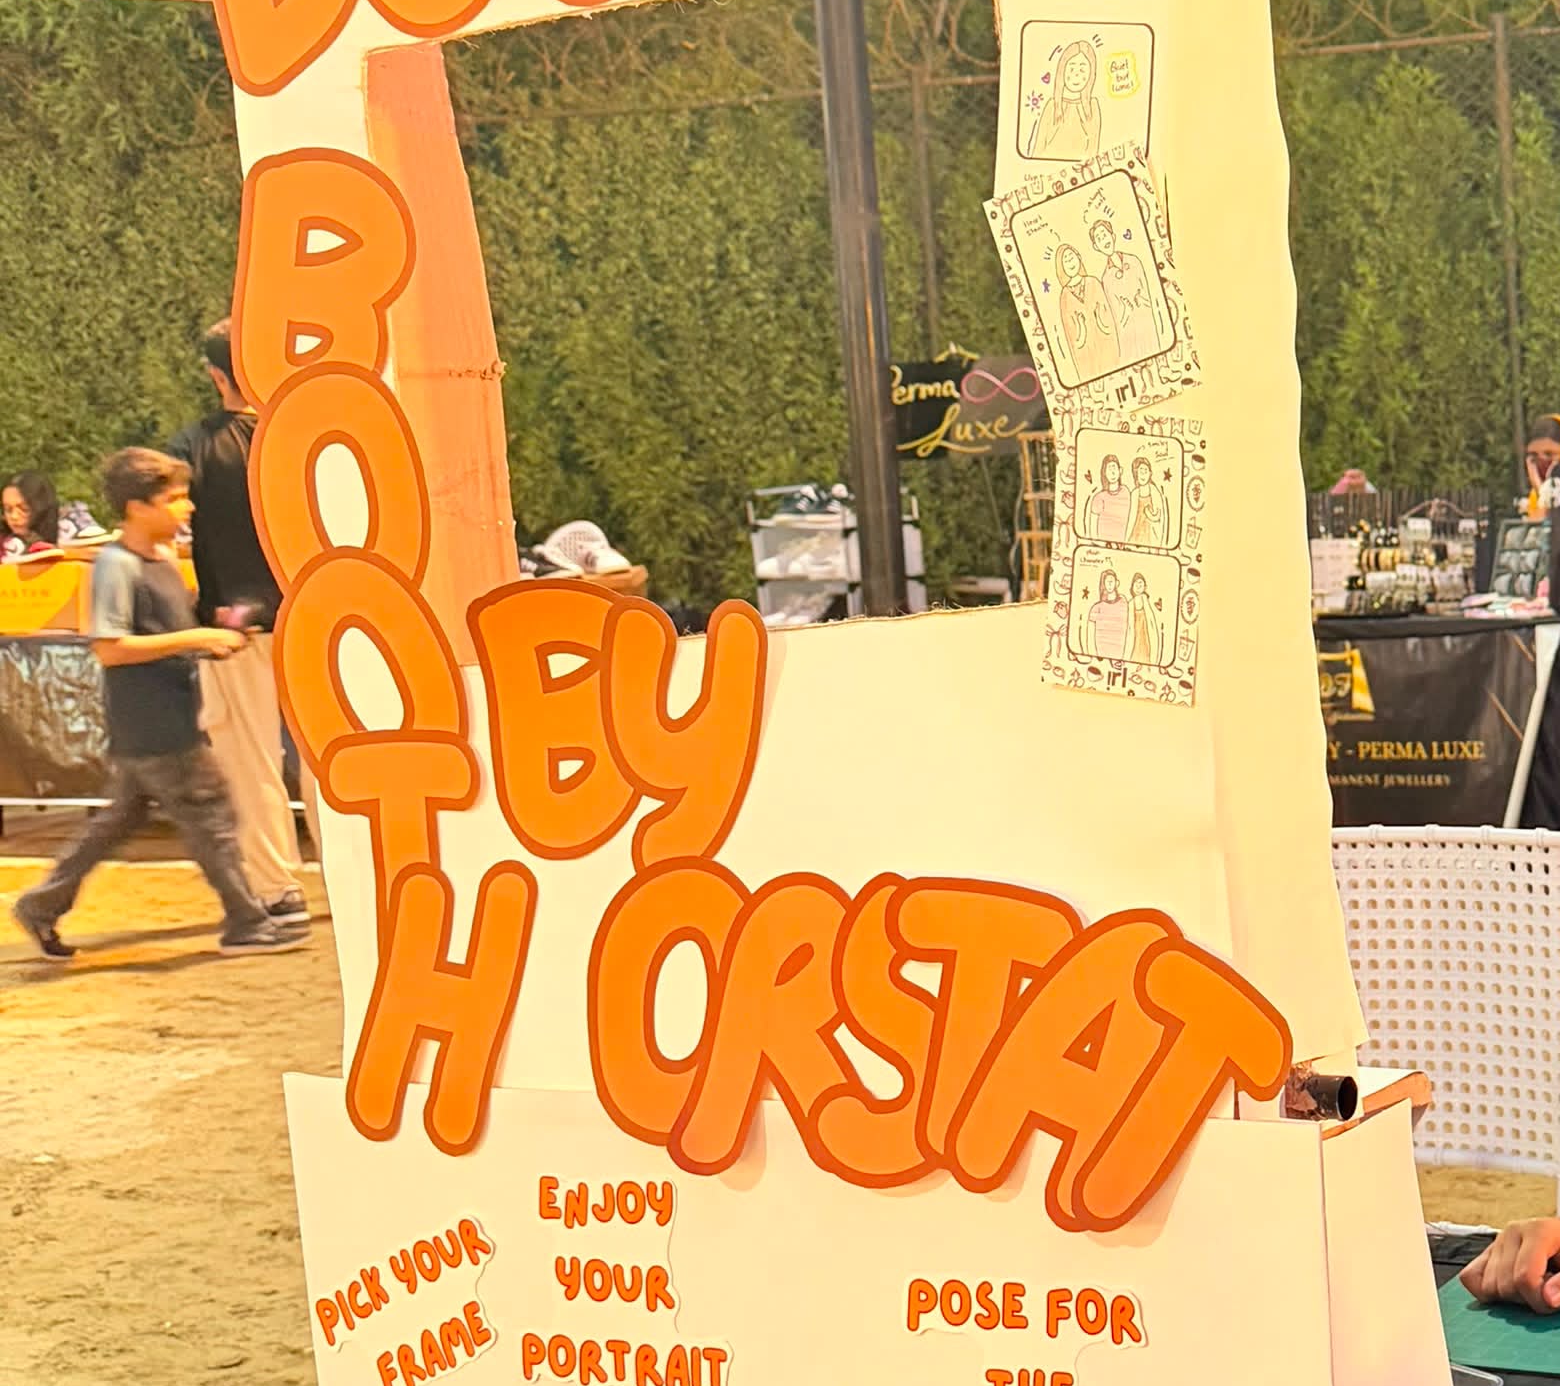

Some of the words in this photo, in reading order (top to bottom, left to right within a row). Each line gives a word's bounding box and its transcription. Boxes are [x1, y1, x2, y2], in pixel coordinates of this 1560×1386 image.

[230, 146, 538, 1156] BOOTH
[467, 578, 768, 875] BY
[1357, 740, 1428, 761] PERMA
[1431, 740, 1487, 761] LUXE
[1329, 773, 1380, 787] MANENT
[588, 856, 1293, 1232] ORSTAT
[539, 1175, 674, 1229] ENJOY
[315, 1266, 390, 1346] PICK
[389, 1219, 491, 1295] YOUR
[555, 1256, 675, 1312] YOUR
[907, 1278, 1029, 1332] POSE
[1046, 1288, 1142, 1345] FOR
